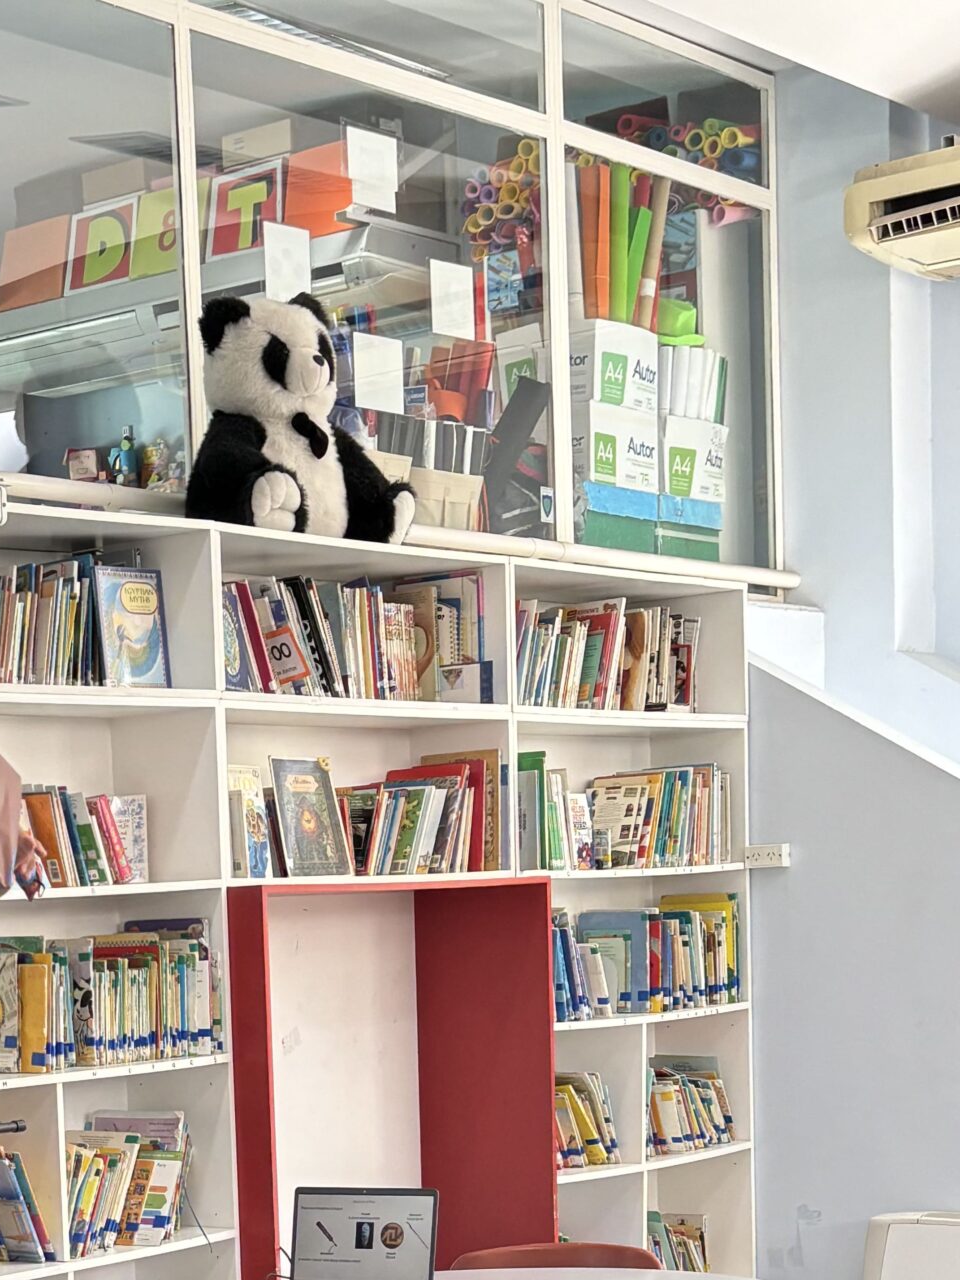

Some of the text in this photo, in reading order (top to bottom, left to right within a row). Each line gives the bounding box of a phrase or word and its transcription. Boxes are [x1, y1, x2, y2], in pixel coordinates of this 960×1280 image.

[83, 213, 126, 284] D
[227, 180, 269, 249] T
[604, 361, 623, 383] A4
[632, 359, 656, 384] Autor
[597, 441, 613, 462] A4
[627, 436, 655, 460] Autor
[672, 455, 691, 475] A4
